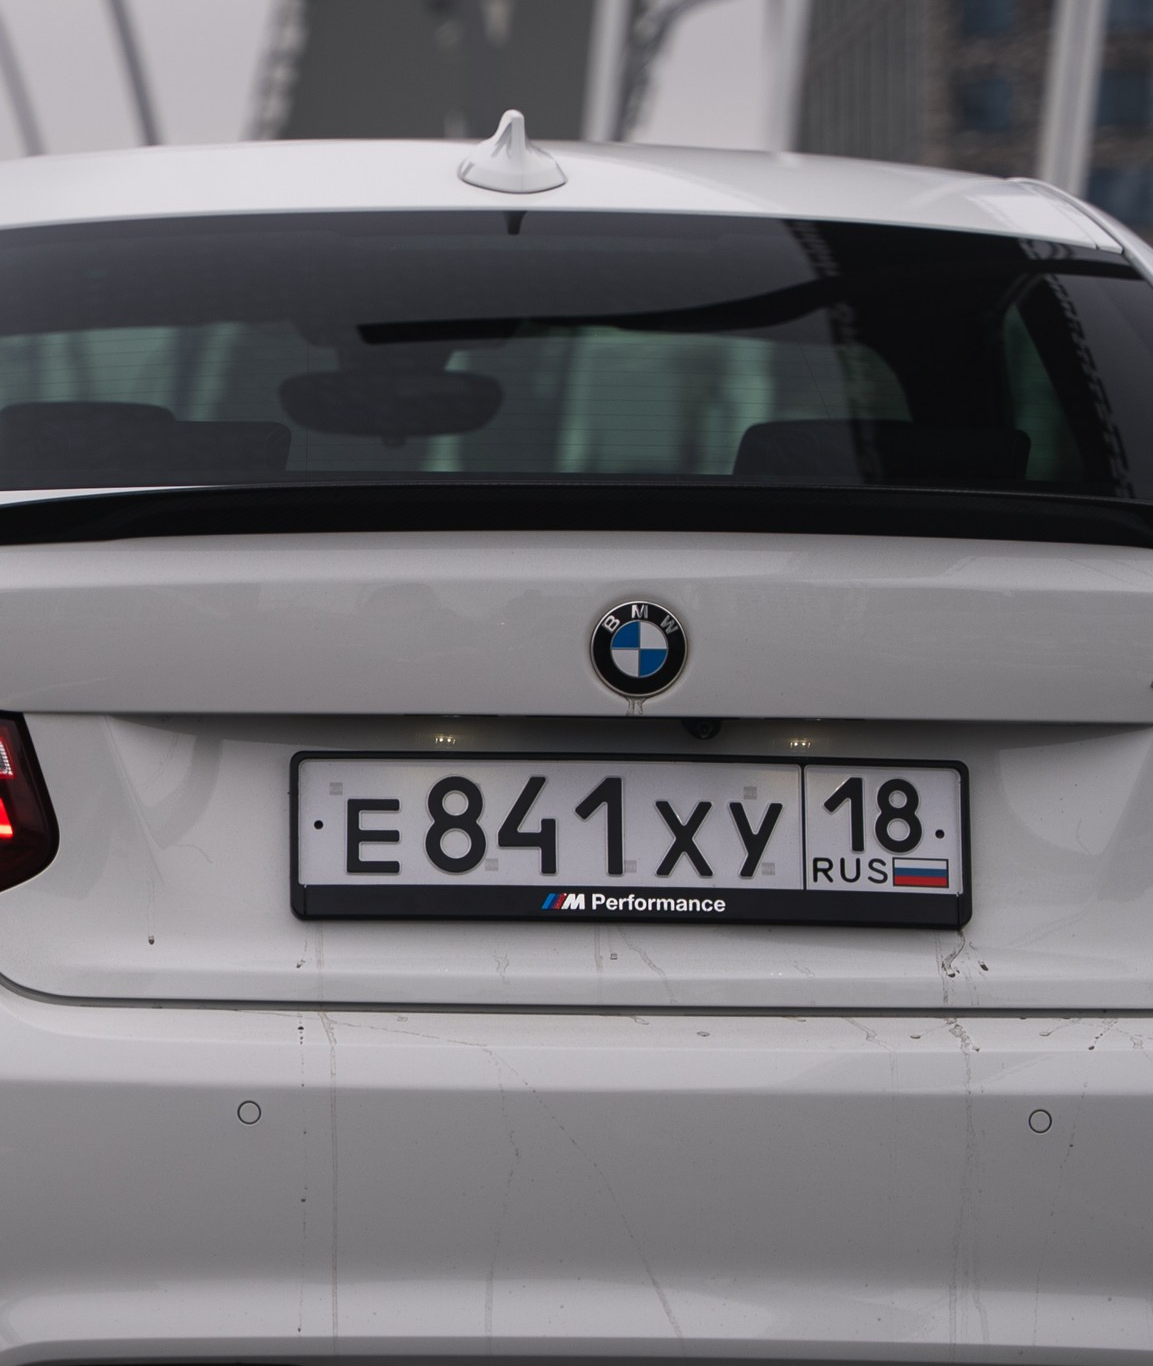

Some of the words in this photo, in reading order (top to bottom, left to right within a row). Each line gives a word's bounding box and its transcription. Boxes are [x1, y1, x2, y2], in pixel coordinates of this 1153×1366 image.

[602, 604, 679, 635] BMW
[824, 777, 923, 853] 18
[812, 857, 889, 884] RUS
[591, 893, 727, 913] Performance
